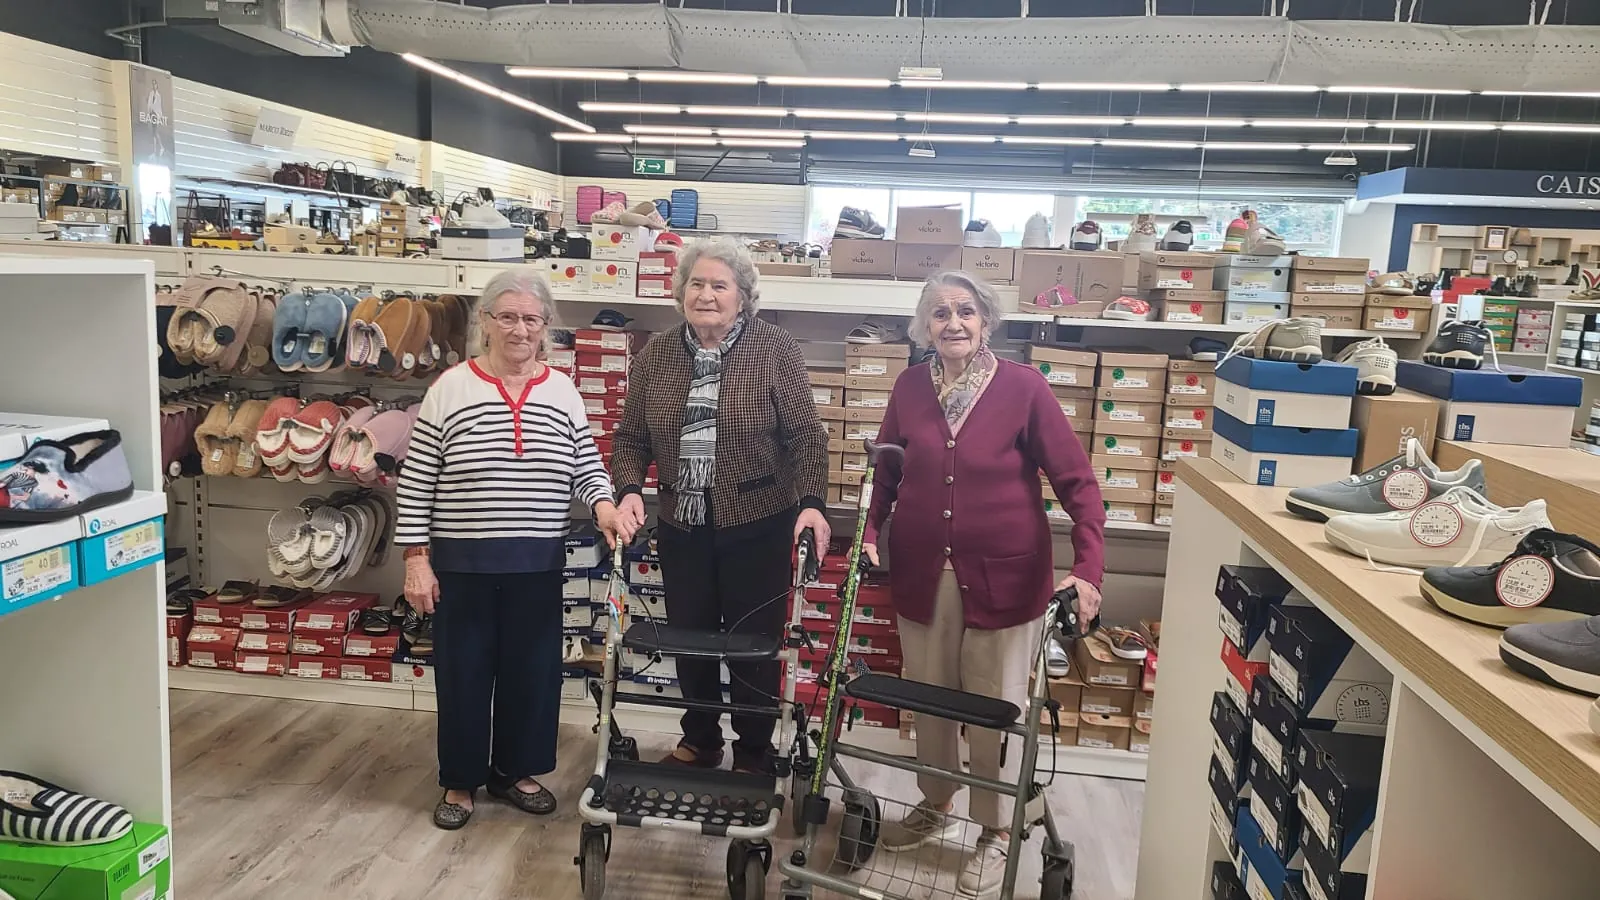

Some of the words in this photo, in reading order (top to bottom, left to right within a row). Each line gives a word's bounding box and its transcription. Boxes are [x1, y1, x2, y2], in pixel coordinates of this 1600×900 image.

[918, 225, 943, 233] victoria
[852, 256, 874, 264] victoria
[975, 259, 999, 268] victoria
[1458, 422, 1470, 430] tbs
[1261, 467, 1272, 475] tbs
[39, 557, 48, 568] 40
[653, 676, 671, 685] inblu
[1354, 697, 1370, 707] tbs
